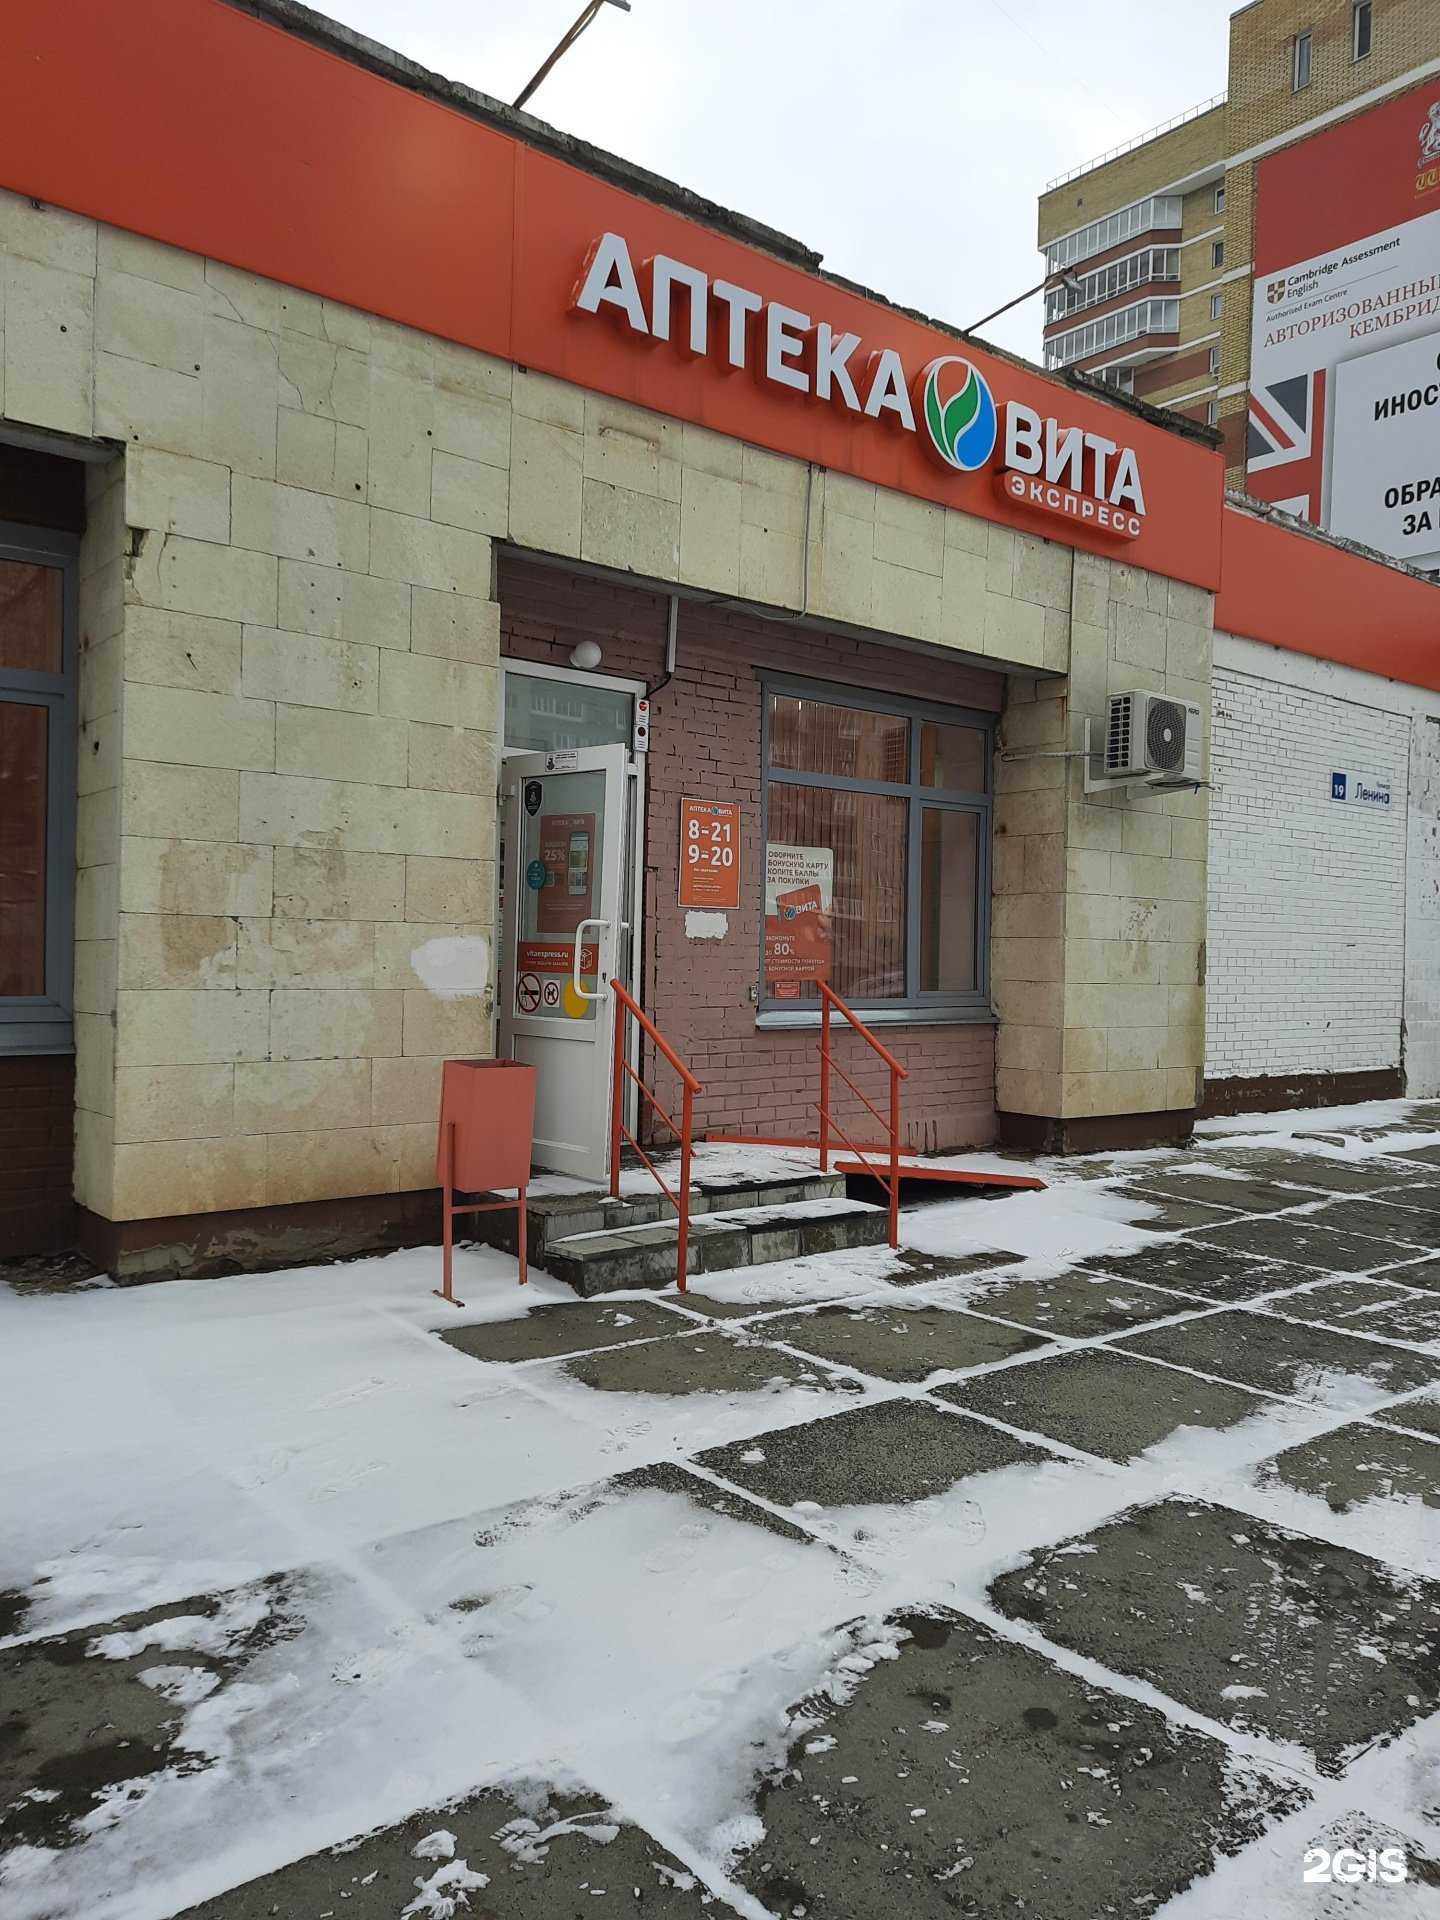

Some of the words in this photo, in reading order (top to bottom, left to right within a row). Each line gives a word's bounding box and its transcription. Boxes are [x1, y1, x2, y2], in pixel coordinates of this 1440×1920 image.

[1287, 262, 1339, 286] Cambridge
[1341, 237, 1400, 267] Assessment
[1287, 280, 1319, 298] English
[1304, 298, 1323, 310] Exam
[1324, 289, 1348, 303] Centre
[1264, 273, 1440, 348] АВТОРИЗОВАННЫ
[577, 231, 917, 432] АПТЕКА
[1004, 400, 1147, 516] ВИТА
[1374, 383, 1440, 421] ИНОС
[1010, 475, 1141, 536] ЭКСПРЕСС
[1402, 511, 1432, 535] ЗА
[1334, 784, 1344, 796] 19
[768, 851, 804, 860] ОФОРМИТЕ
[768, 860, 804, 868] БОНУСНУЮ
[768, 868, 793, 876] КОПИТЕ
[778, 877, 809, 885] ПОКУПКИ
[796, 901, 817, 913] ВИТА
